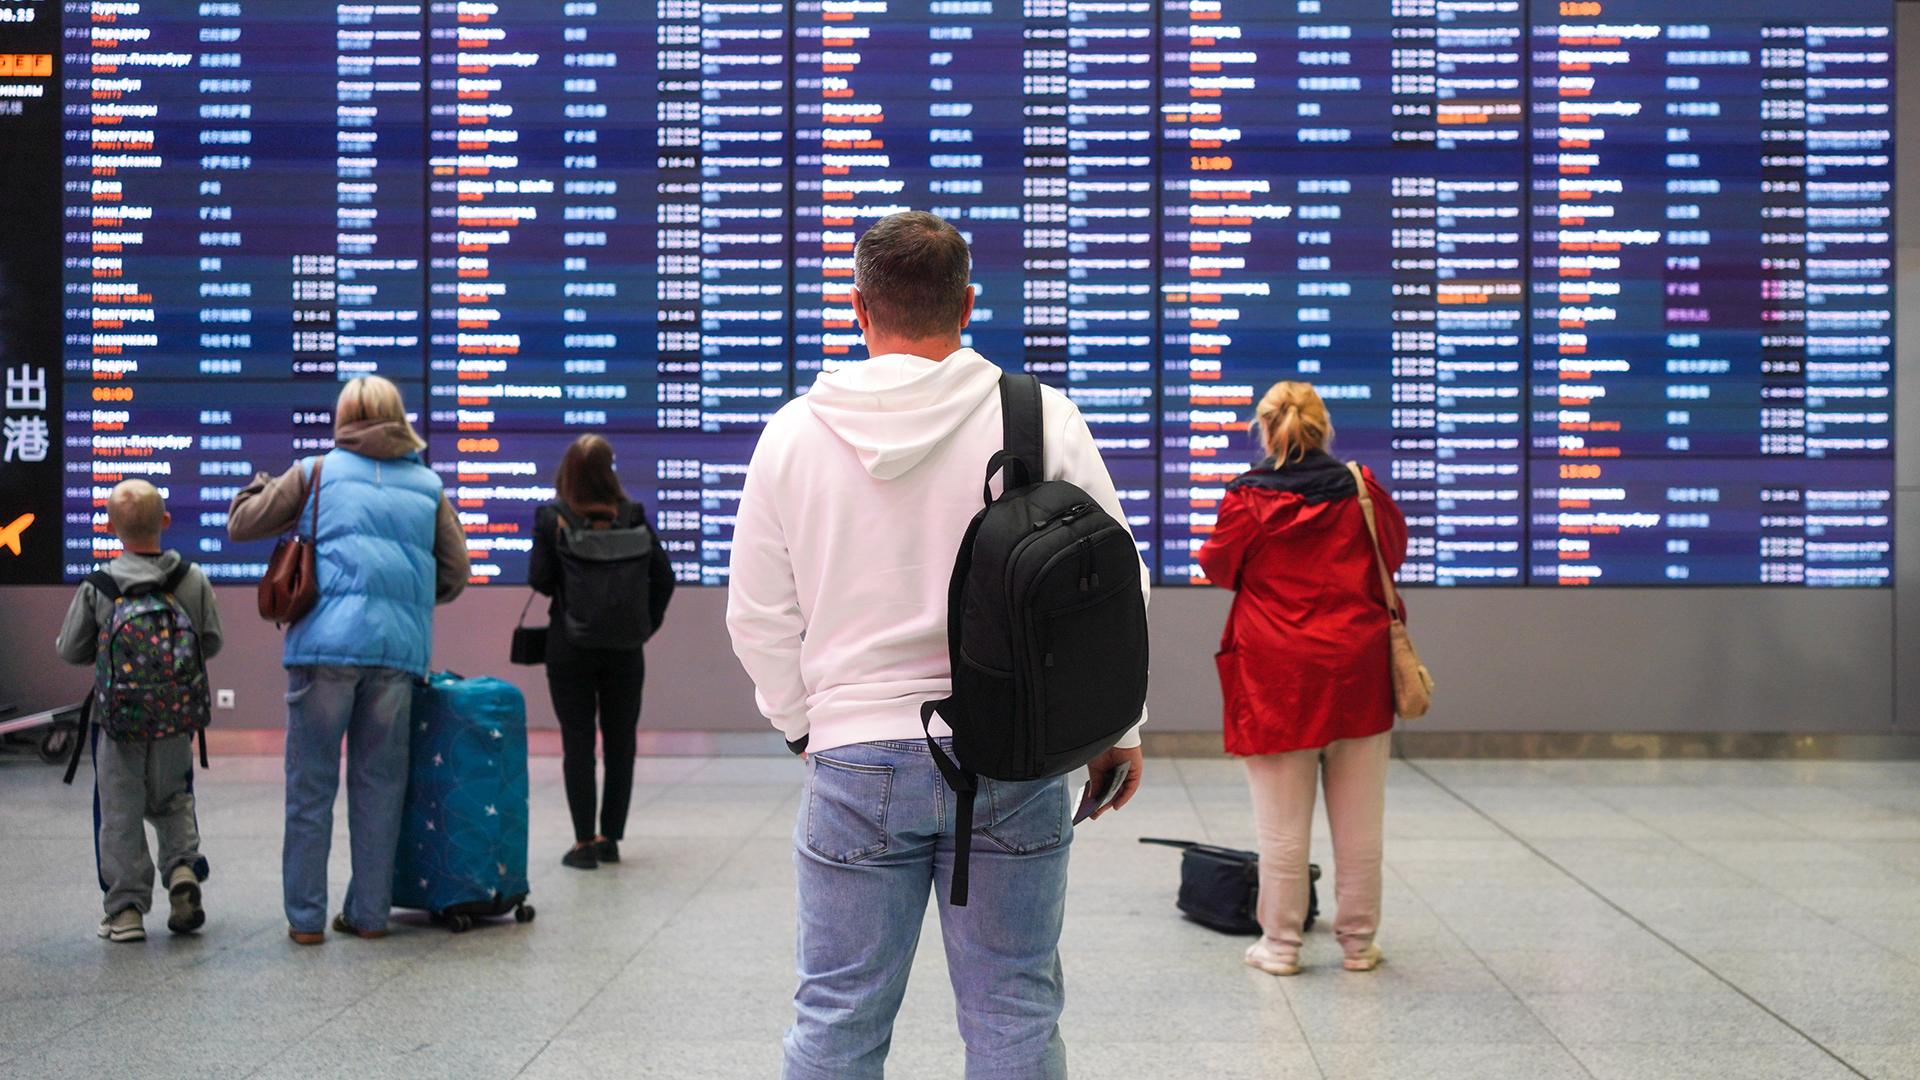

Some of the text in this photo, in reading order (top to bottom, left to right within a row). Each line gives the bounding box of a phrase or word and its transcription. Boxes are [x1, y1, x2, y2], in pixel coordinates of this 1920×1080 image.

[92, 53, 193, 67] Санкт-Петербург
[92, 78, 142, 92] Стамбул
[92, 104, 158, 118] Чебоксары
[92, 130, 155, 144] Волгоград
[92, 155, 162, 168] Касабланка
[3, 363, 49, 462] 出港
[93, 435, 193, 450] Санкт-Петербург
[93, 461, 171, 475] Калининград
